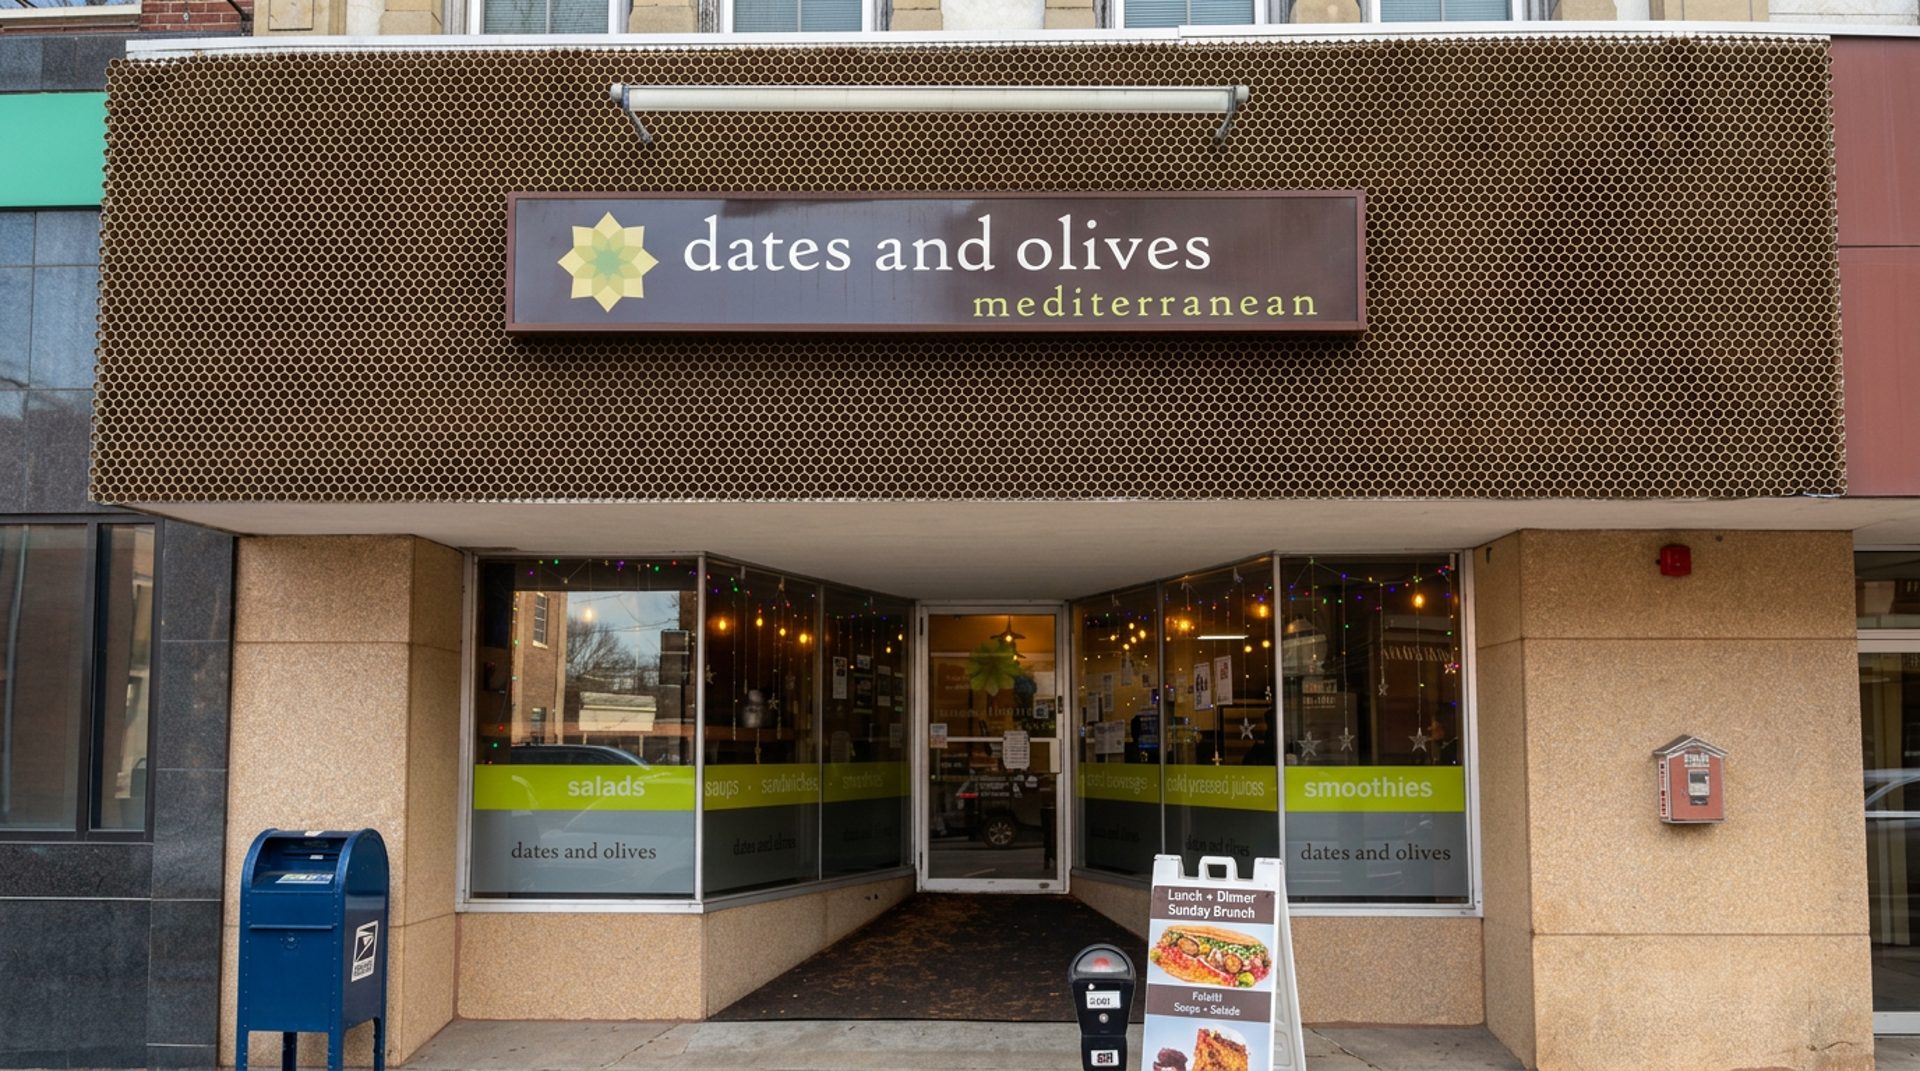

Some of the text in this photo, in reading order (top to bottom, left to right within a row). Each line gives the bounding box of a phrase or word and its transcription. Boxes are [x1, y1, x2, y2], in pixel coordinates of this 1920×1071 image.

[684, 215, 1211, 272] dates and olives
[972, 287, 1318, 318] mediterranean
[567, 776, 645, 798] salads
[1304, 779, 1433, 799] smoothies
[511, 841, 657, 861] dates and olives
[1300, 843, 1451, 863] dates and olives
[1168, 903, 1256, 920] Sunday Brunch
